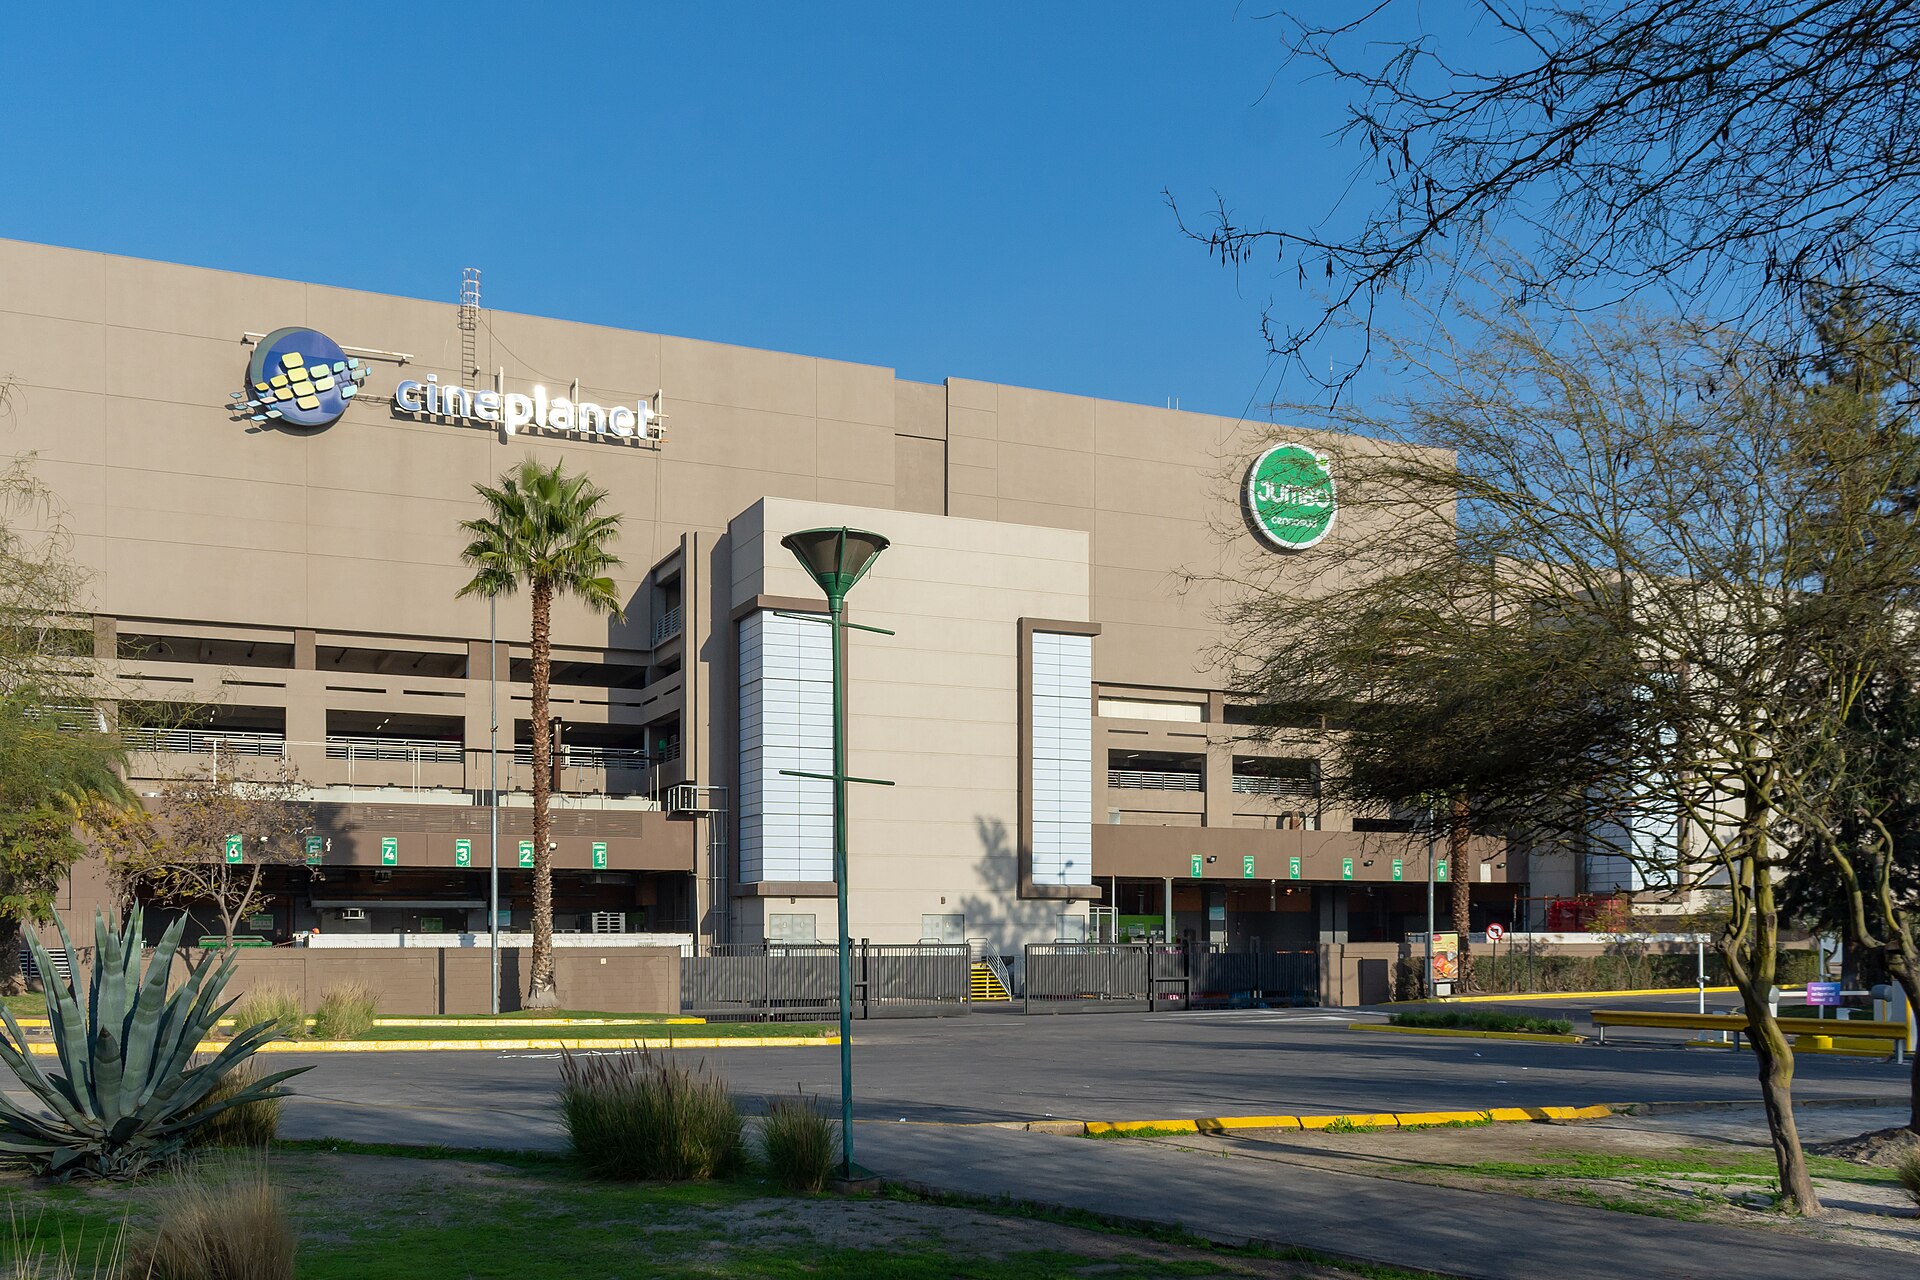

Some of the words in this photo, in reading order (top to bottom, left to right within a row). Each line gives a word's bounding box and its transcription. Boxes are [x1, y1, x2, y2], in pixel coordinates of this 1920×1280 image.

[396, 374, 654, 439] cineplanet
[229, 844, 239, 858] 6
[384, 846, 395, 860] 4
[457, 848, 468, 861] 3
[520, 849, 532, 862] 2
[596, 850, 605, 864] 1
[1194, 862, 1200, 874] 1
[1245, 864, 1252, 874] 2
[1292, 864, 1299, 875] 3
[1344, 866, 1351, 876] 4
[1394, 866, 1401, 877] 5
[1439, 867, 1445, 877] 6
